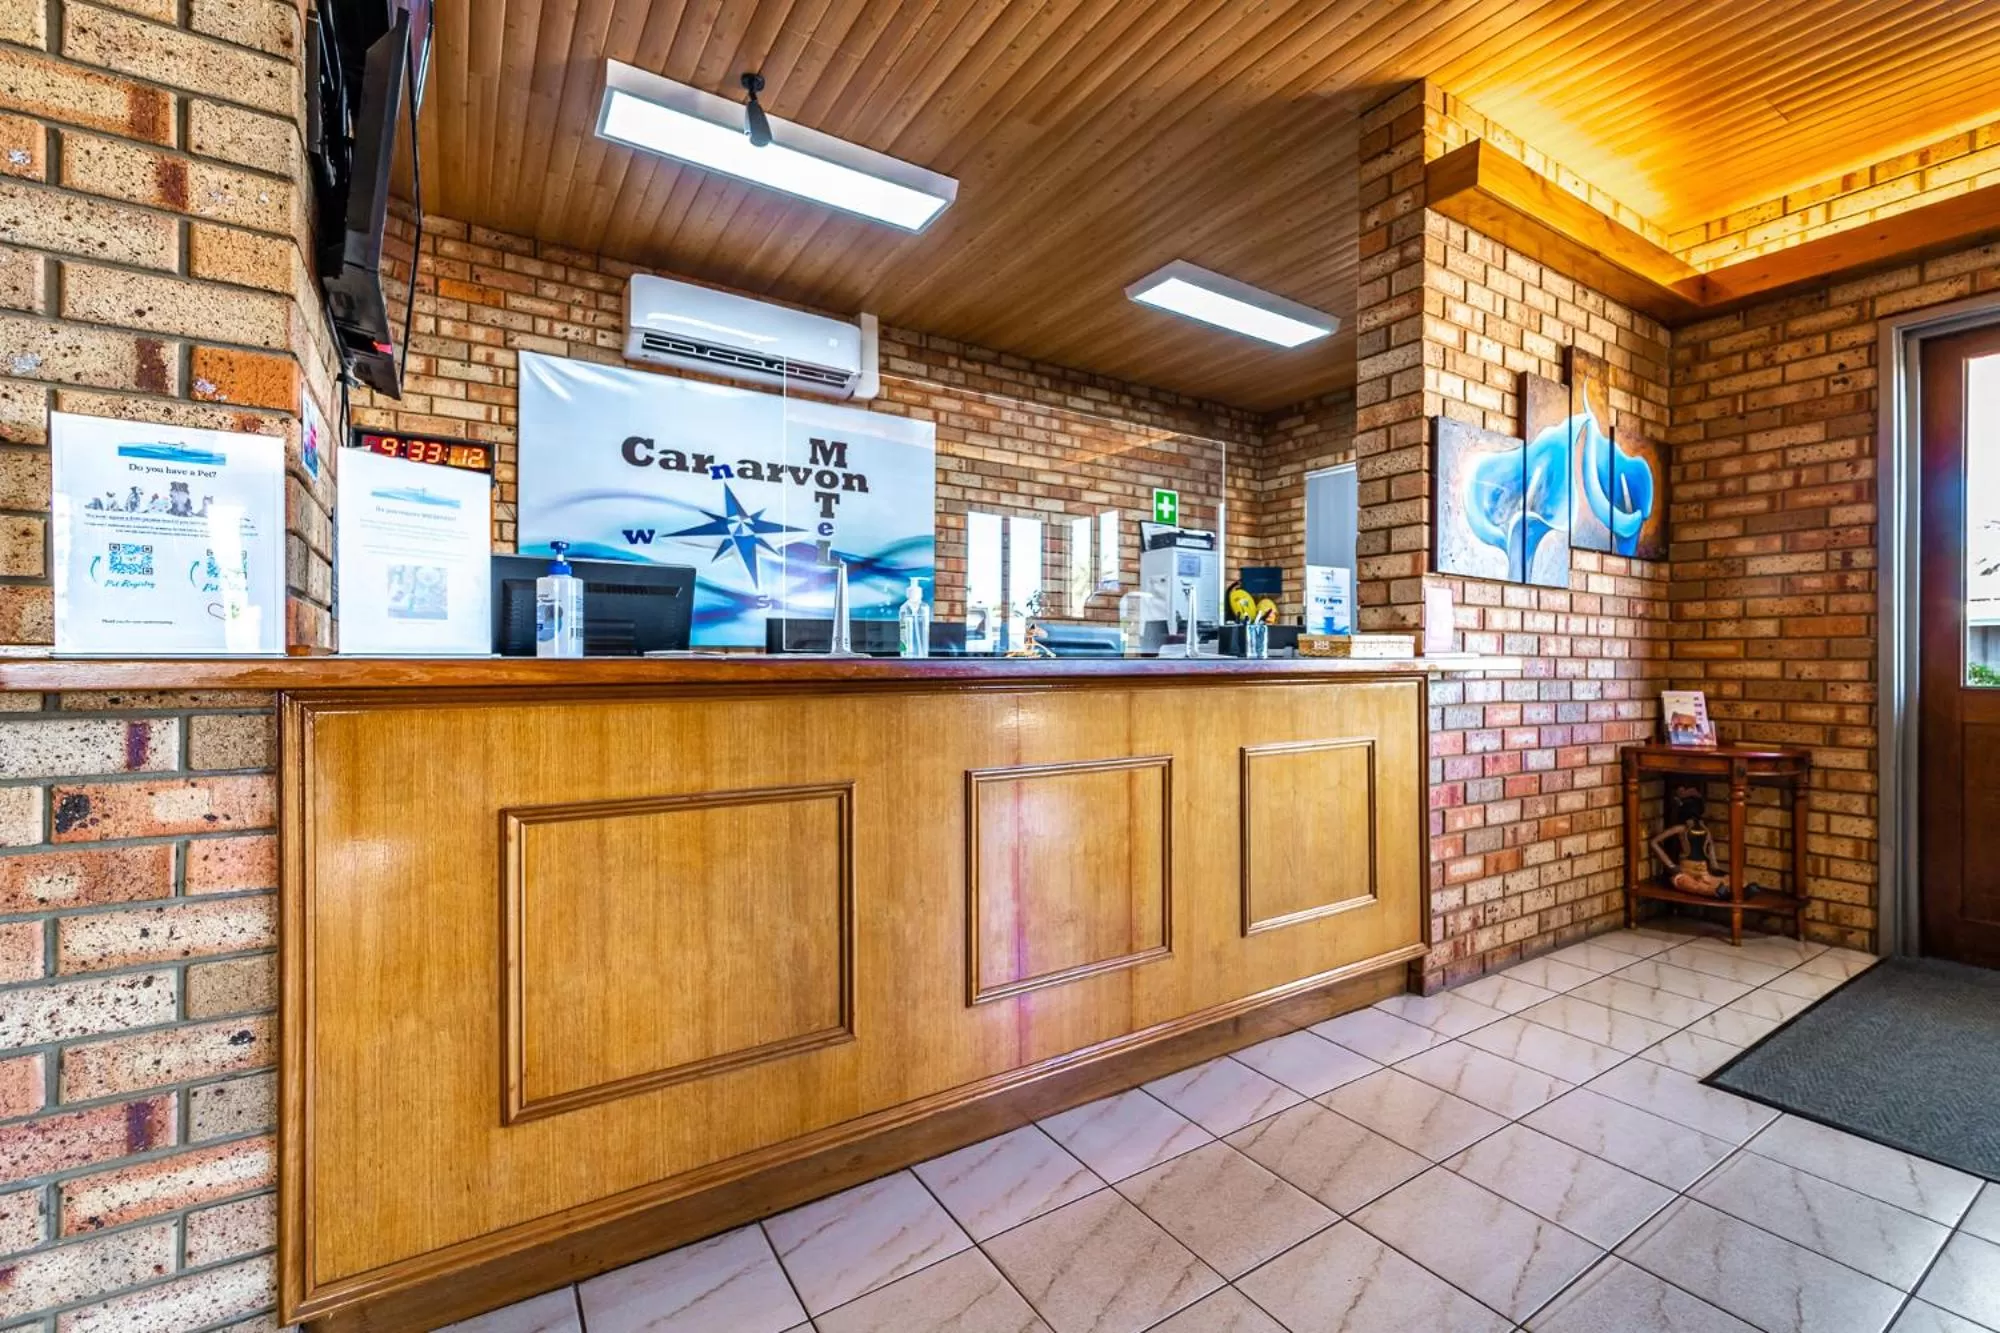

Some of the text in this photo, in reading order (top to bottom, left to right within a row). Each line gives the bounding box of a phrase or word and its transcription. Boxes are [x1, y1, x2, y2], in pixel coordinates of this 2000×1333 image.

[128, 463, 144, 472] Do
[145, 466, 164, 474] you
[166, 466, 188, 476] have
[197, 470, 217, 478] Pet?
[621, 435, 869, 494] Carnarvon
